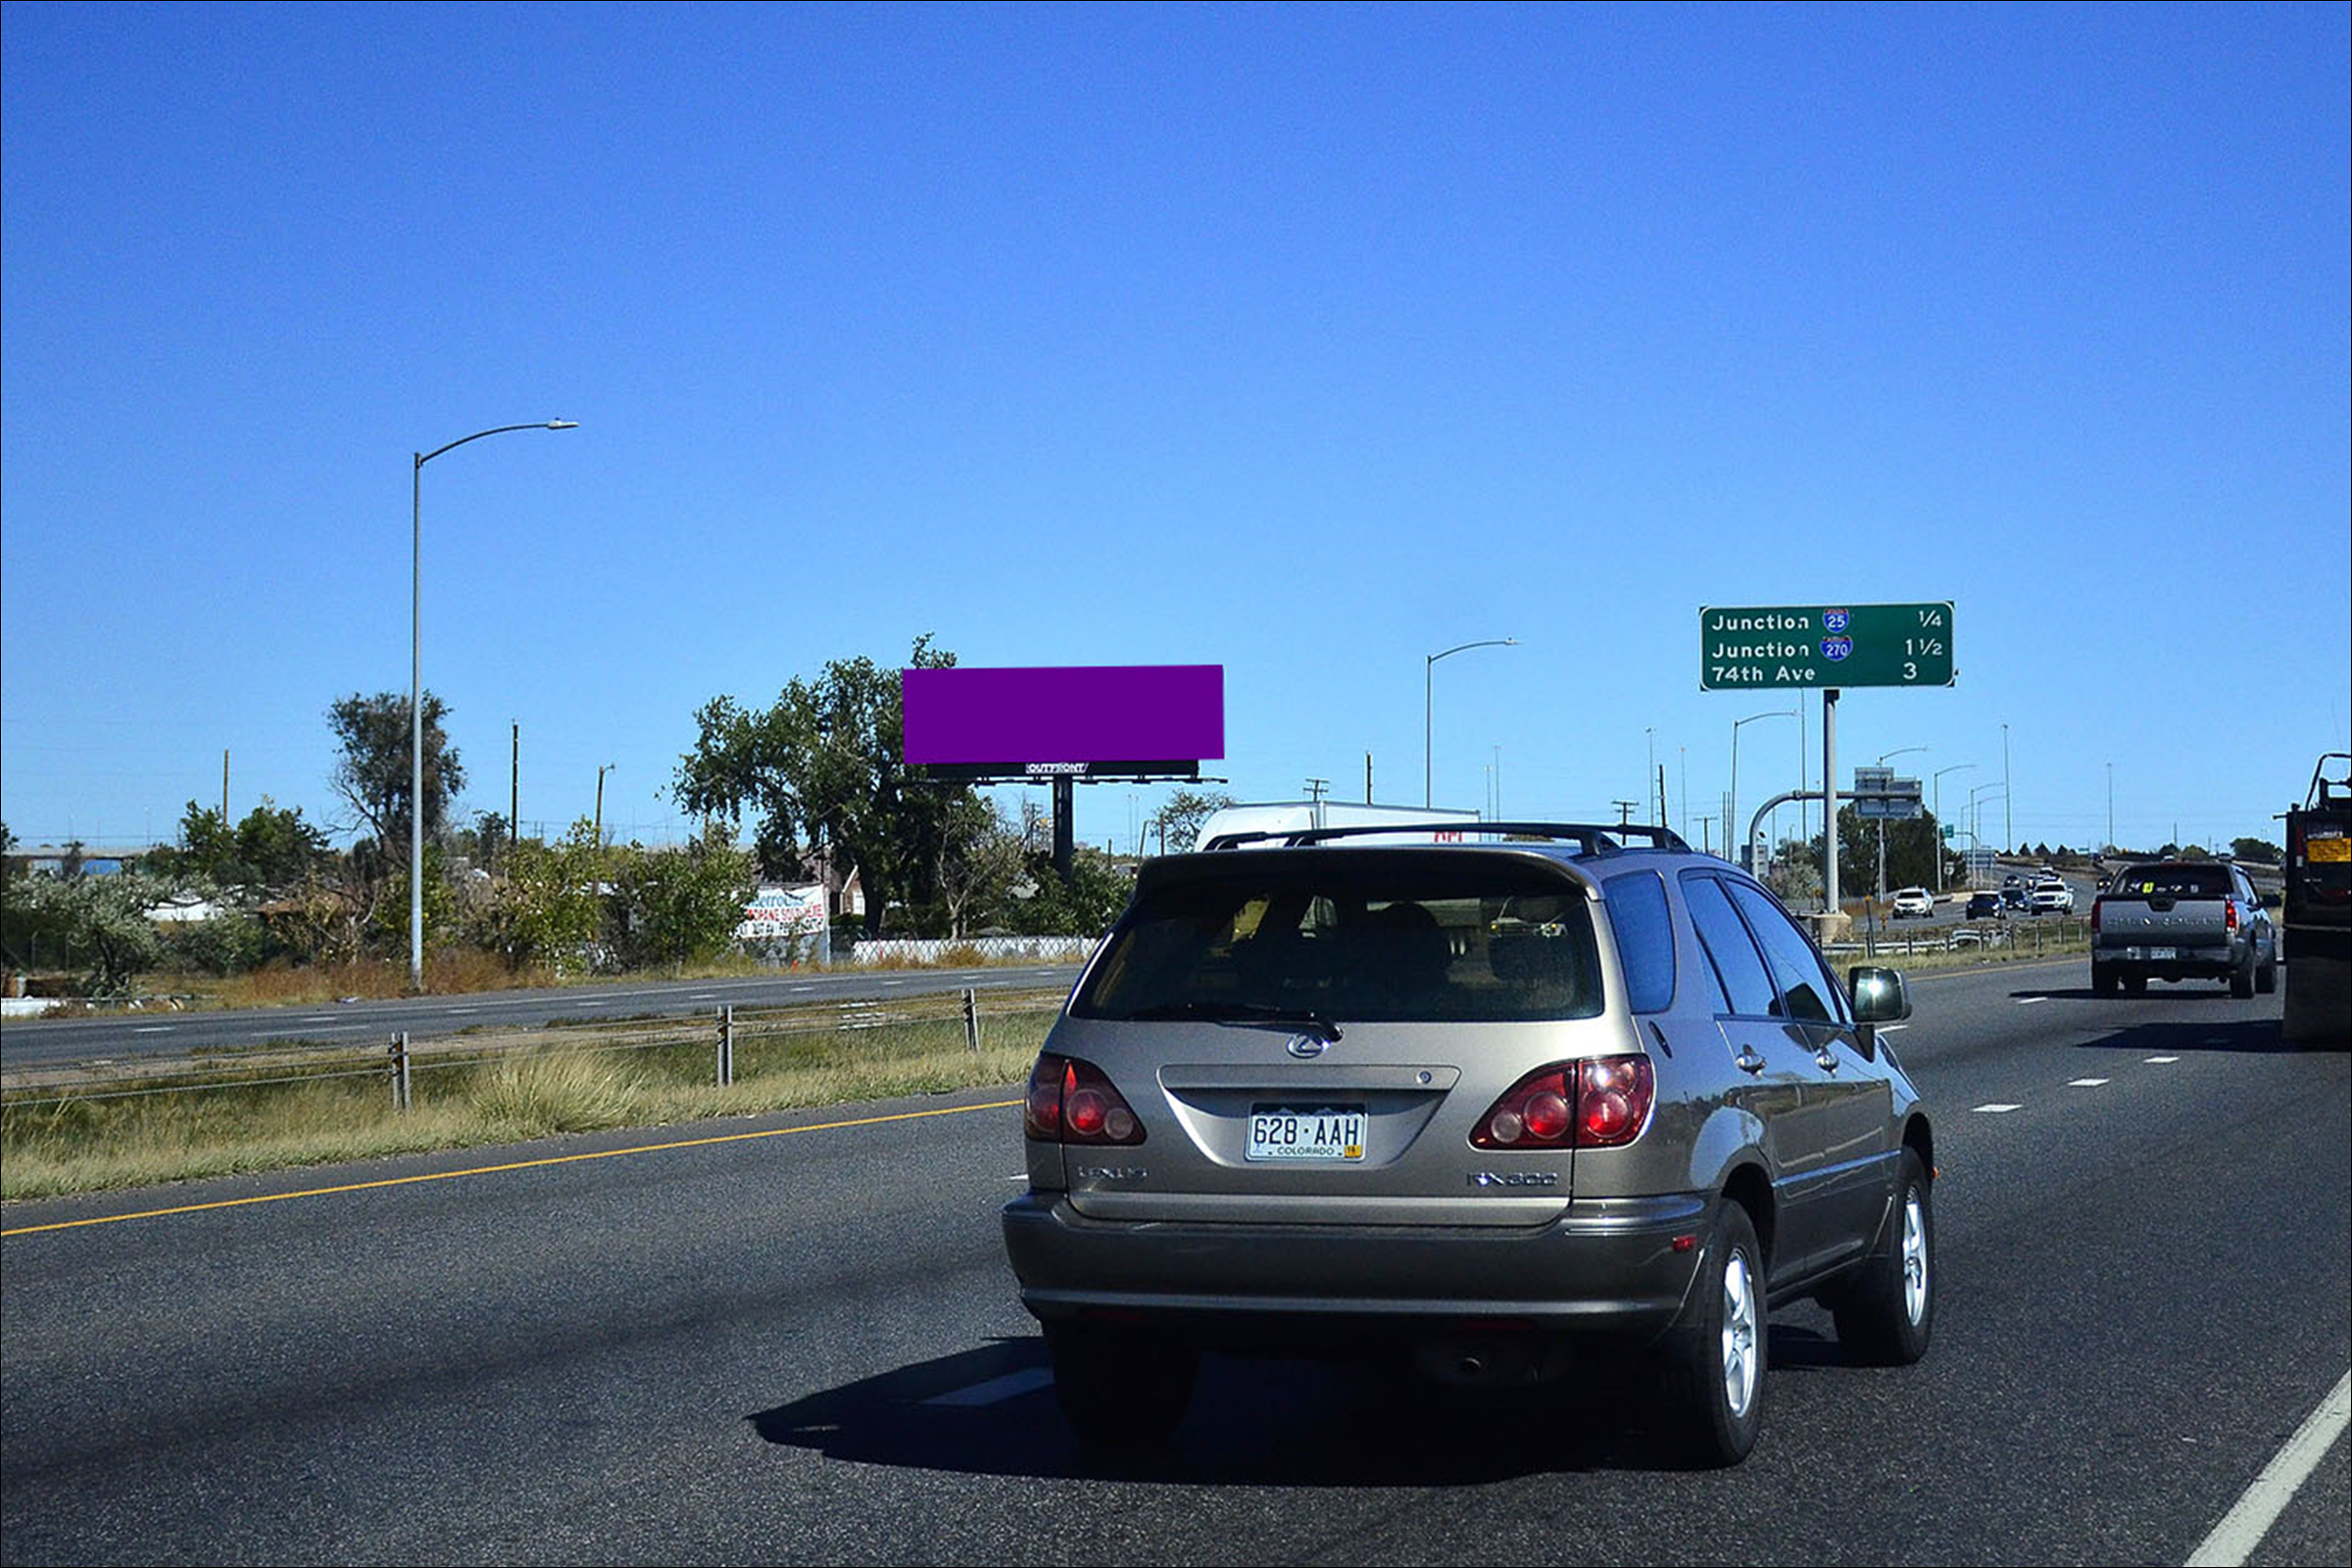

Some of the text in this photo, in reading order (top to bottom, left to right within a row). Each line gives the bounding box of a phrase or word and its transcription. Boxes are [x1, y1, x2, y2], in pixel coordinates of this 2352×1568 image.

[1712, 615, 1809, 630] Junction
[1828, 614, 1846, 628] 25
[1712, 643, 1809, 659] Junction
[1826, 644, 1848, 657] 270
[1712, 662, 1917, 682] 74th Ave 3
[1277, 1147, 1335, 1155] COLORADO
